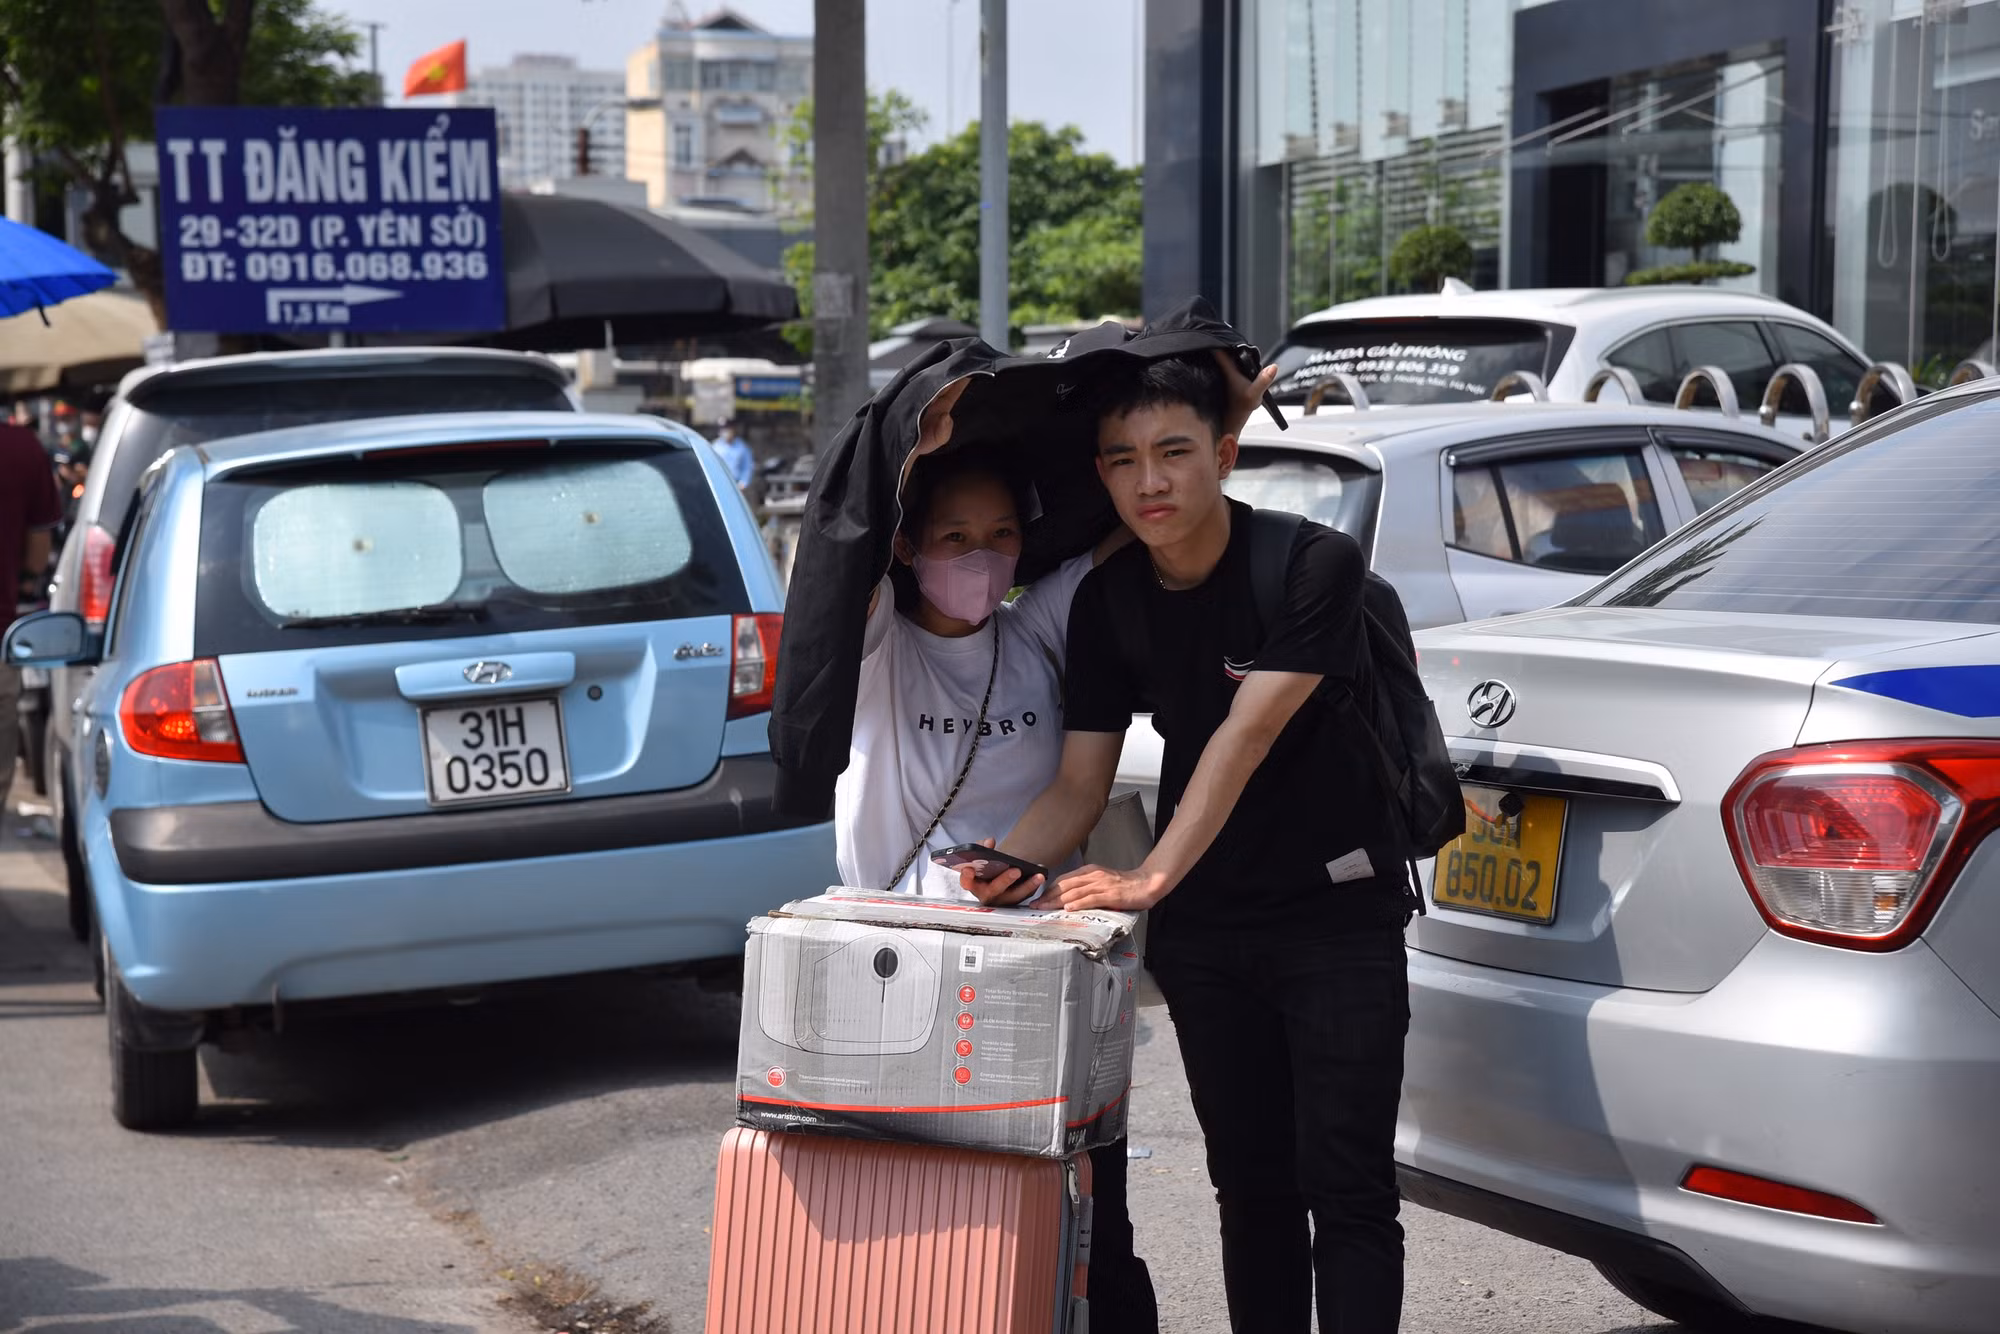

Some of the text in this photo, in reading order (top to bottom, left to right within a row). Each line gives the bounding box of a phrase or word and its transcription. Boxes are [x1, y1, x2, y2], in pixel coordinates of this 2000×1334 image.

[243, 126, 367, 203] ĐĂNG
[378, 114, 491, 202] KIỂM
[179, 204, 487, 252] 29-32D (P. YÊN SỞ)
[182, 250, 489, 283] ĐT: 0916.068.936
[316, 303, 349, 324] Km
[1304, 346, 1364, 365] MAZDA
[458, 707, 527, 751] 31H
[446, 747, 550, 794] 0350
[1445, 850, 1541, 911] 850.02
[760, 1111, 818, 1123] www.ariston.com
